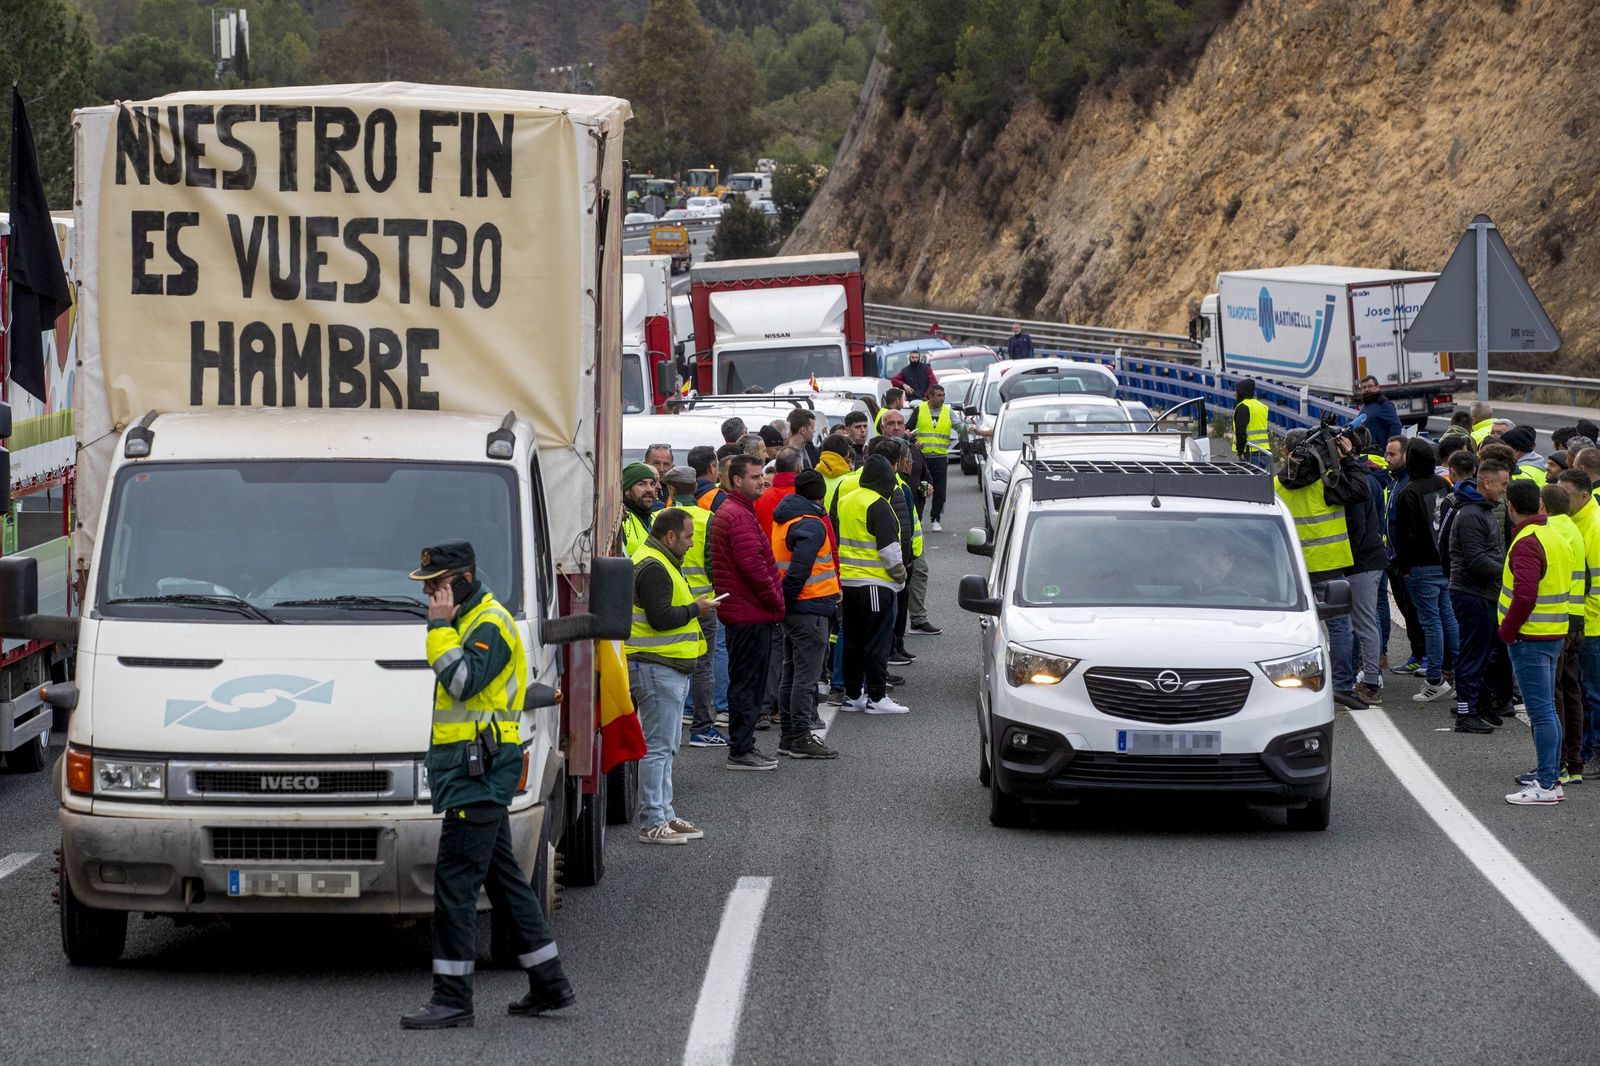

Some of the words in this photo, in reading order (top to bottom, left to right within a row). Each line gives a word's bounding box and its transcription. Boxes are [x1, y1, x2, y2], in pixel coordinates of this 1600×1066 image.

[115, 103, 398, 193] NUESTRO
[417, 108, 515, 198] FIN
[131, 210, 200, 296] ES
[227, 213, 502, 309] VUESTRO
[1365, 306, 1391, 317] Jose
[1394, 304, 1425, 314] Man
[190, 320, 440, 410] HAMBRE
[260, 776, 320, 790] IVECO
